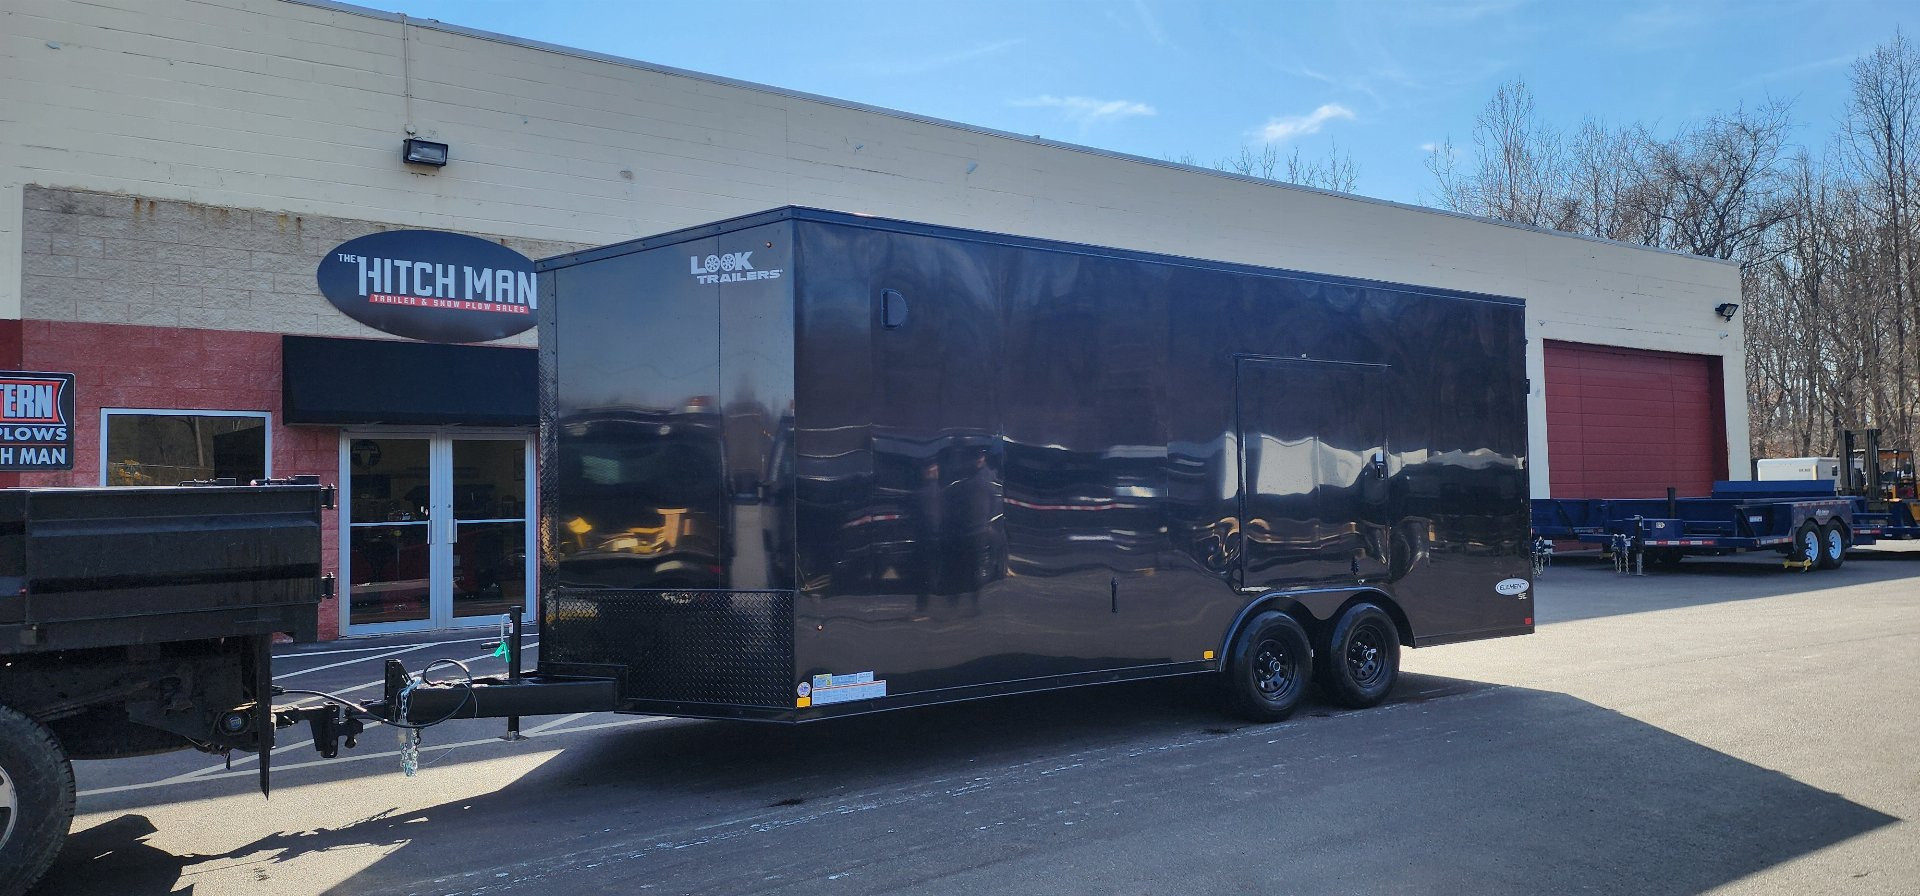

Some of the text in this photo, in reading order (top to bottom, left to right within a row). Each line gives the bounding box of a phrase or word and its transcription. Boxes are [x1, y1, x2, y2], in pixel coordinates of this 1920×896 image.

[690, 251, 754, 275] LOOK
[338, 253, 538, 310] THE HITCH MAN
[373, 294, 415, 305] TRAILER
[433, 299, 460, 308] SNOW
[496, 304, 525, 313] SALES
[0, 384, 53, 418] ERN
[0, 447, 66, 465] H MAN
